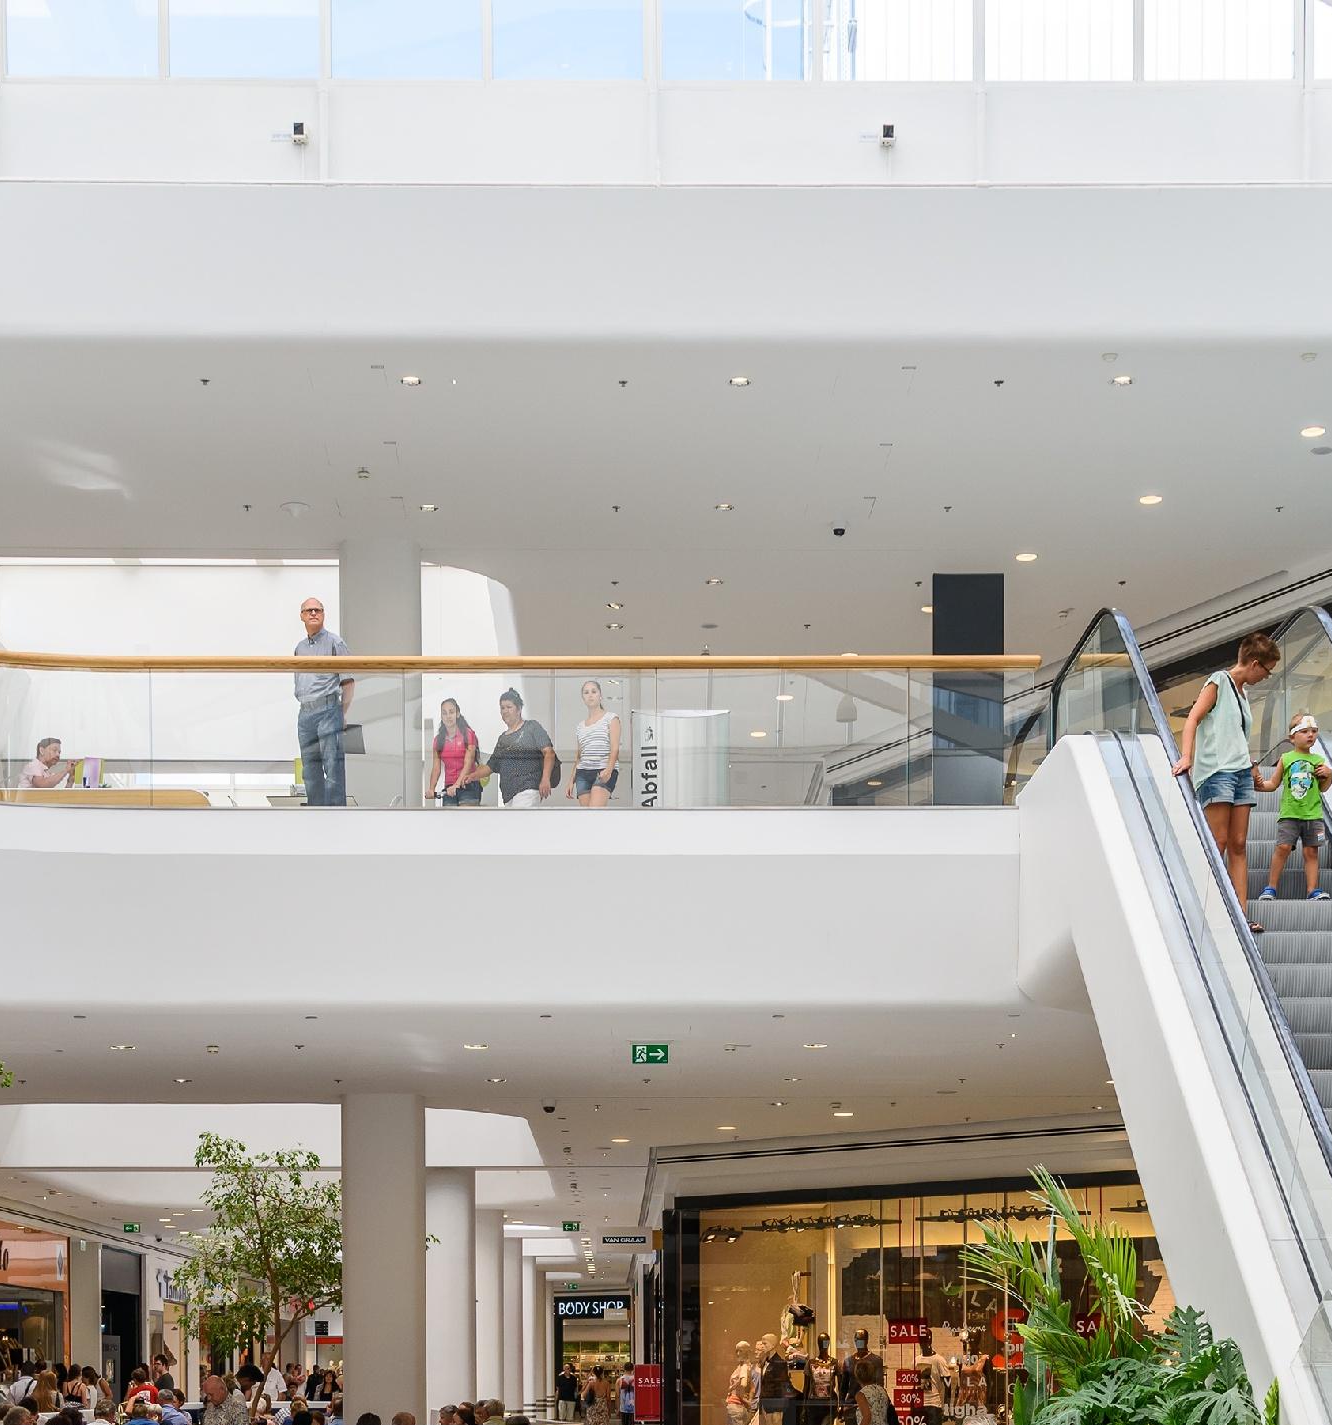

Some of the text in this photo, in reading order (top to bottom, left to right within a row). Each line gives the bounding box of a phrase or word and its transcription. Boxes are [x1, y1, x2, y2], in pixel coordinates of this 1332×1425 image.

[640, 746, 658, 808] Abfall
[558, 1301, 624, 1315] BODY SHOP
[890, 1324, 927, 1338] SALE
[1076, 1320, 1098, 1333] SA
[897, 1373, 919, 1384] -20%
[896, 1393, 921, 1404] -30%
